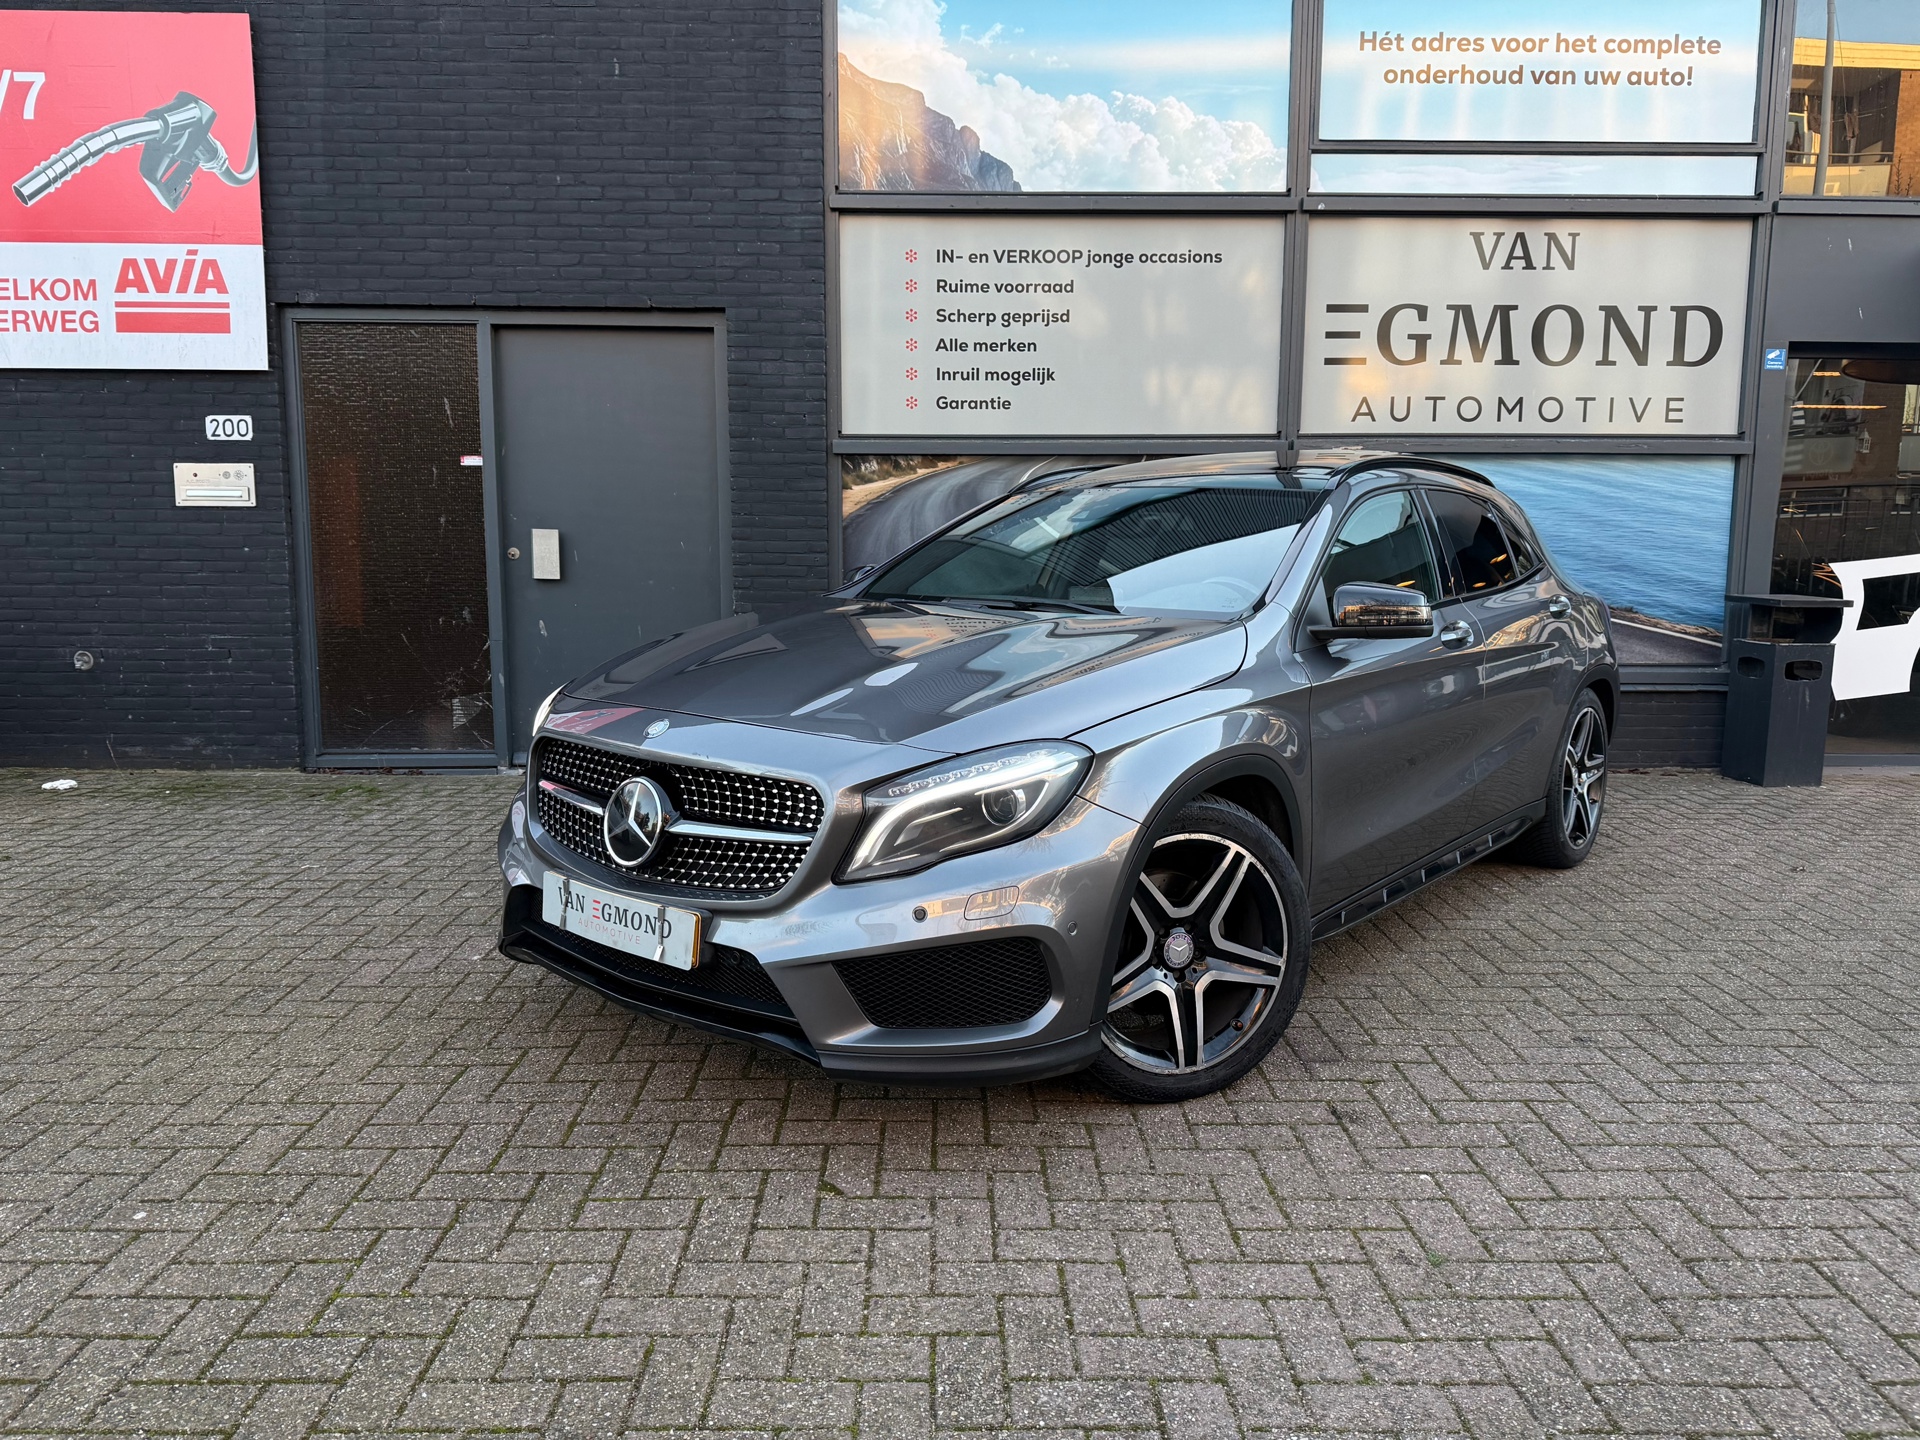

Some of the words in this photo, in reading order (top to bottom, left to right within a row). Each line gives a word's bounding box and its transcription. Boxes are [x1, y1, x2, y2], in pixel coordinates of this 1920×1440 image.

[1358, 31, 1405, 52] Hét
[1411, 32, 1485, 53] adres
[1491, 34, 1549, 53] voor
[1555, 33, 1598, 54] het
[1603, 35, 1722, 59] complete
[1383, 64, 1524, 85] onderhoud
[1530, 69, 1577, 86] van
[1583, 70, 1621, 86] uw
[1626, 66, 1694, 87] auto!
[936, 249, 963, 263] IN-
[968, 252, 989, 263] en
[993, 249, 1083, 264] VERKOOP
[1086, 249, 1134, 268] jonge
[1138, 250, 1223, 264] occasions
[1469, 231, 1581, 271] VAN
[936, 279, 990, 294] Ruime
[994, 279, 1075, 294] voorraad
[936, 308, 996, 327] Scherp
[1000, 308, 1070, 328] geprijsd
[935, 338, 969, 352] Alle
[973, 338, 1037, 352] merken
[1324, 303, 1724, 367] EGMOND
[936, 367, 980, 382] Inruil
[984, 367, 1056, 386] mogelijk
[936, 395, 1012, 411] Garantie
[1351, 396, 1685, 423] AUTOMOTIVE
[209, 418, 249, 437] 200
[577, 917, 641, 945] AUTOMOTIVE
